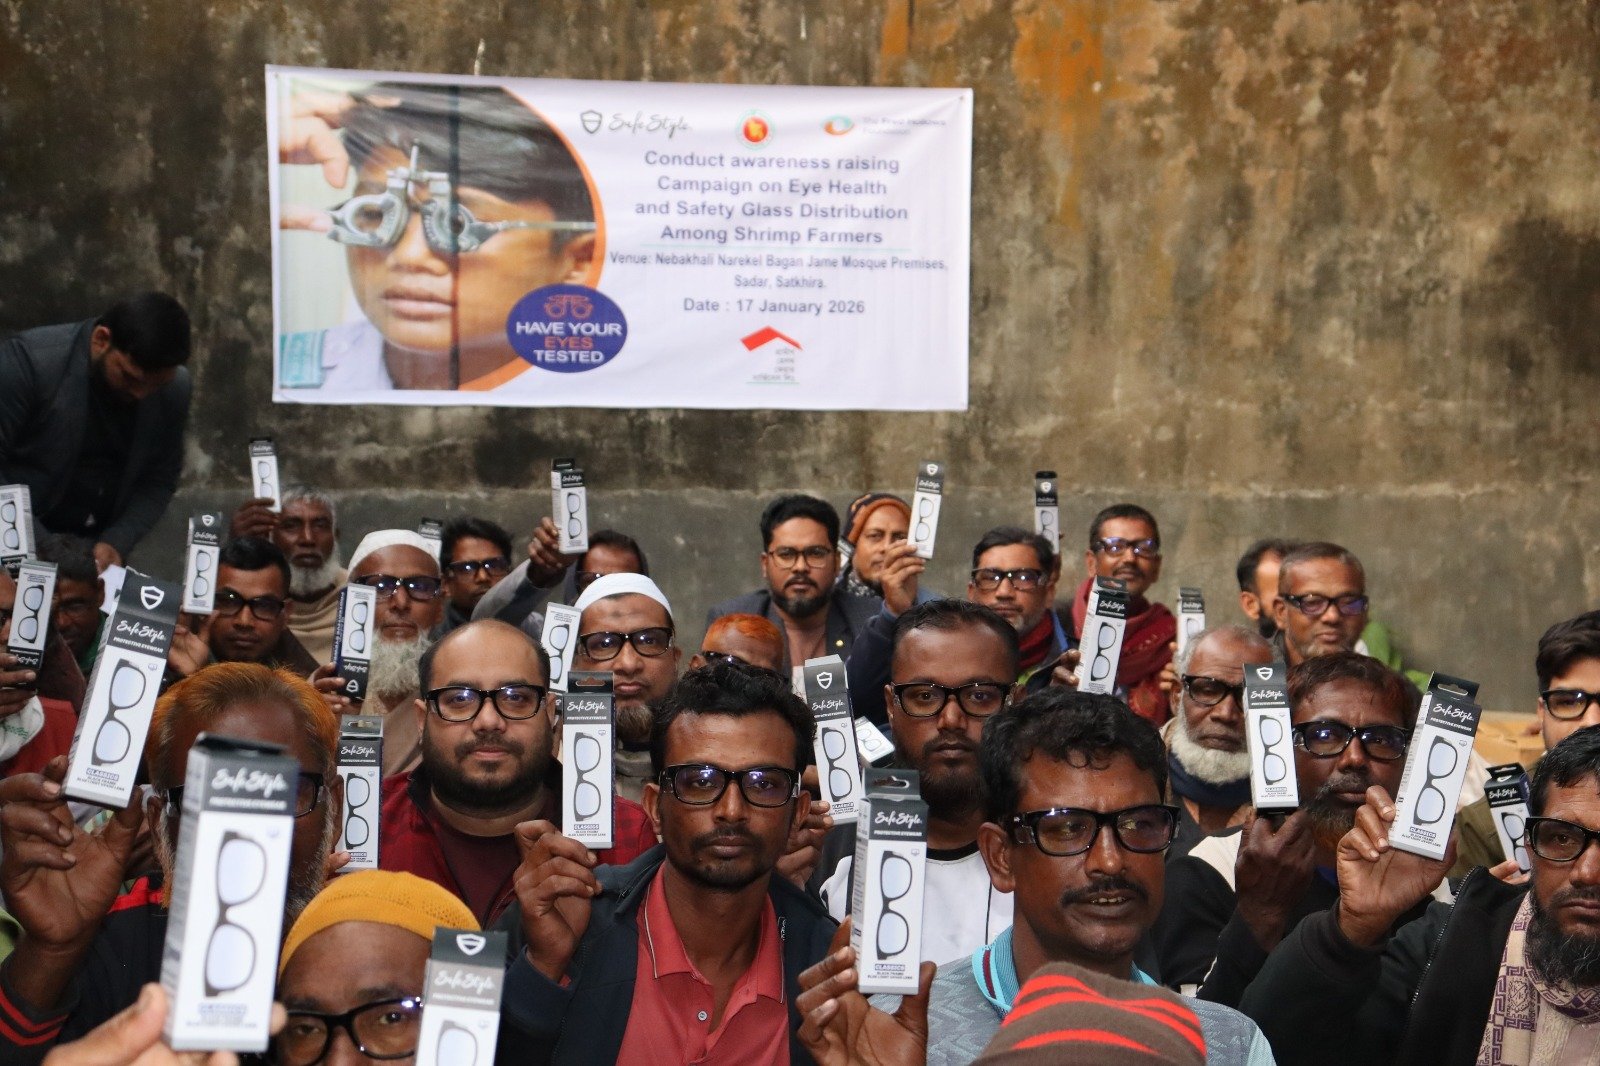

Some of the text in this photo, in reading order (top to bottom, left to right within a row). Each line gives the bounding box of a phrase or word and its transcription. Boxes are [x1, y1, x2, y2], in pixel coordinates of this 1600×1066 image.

[644, 151, 899, 174] Conduct awareness raising
[657, 175, 887, 196] Campaign on Eye Health
[635, 201, 908, 219] and Safety Glass Distribution
[661, 225, 883, 243] Among Shrimp Farmers
[610, 252, 651, 264] Venue:
[718, 253, 762, 266] Narekel
[766, 255, 803, 269] Bagan
[808, 255, 838, 268] Jame
[842, 256, 887, 271] Mosque
[891, 256, 948, 270] Premises,
[734, 275, 772, 289] Sadar,
[684, 298, 719, 312] Date
[737, 299, 752, 312] 17
[759, 300, 822, 316] January
[828, 300, 865, 313] 2026
[516, 321, 623, 336] HAVE YOUR
[544, 336, 594, 349] EYES
[533, 349, 605, 364] TESTED
